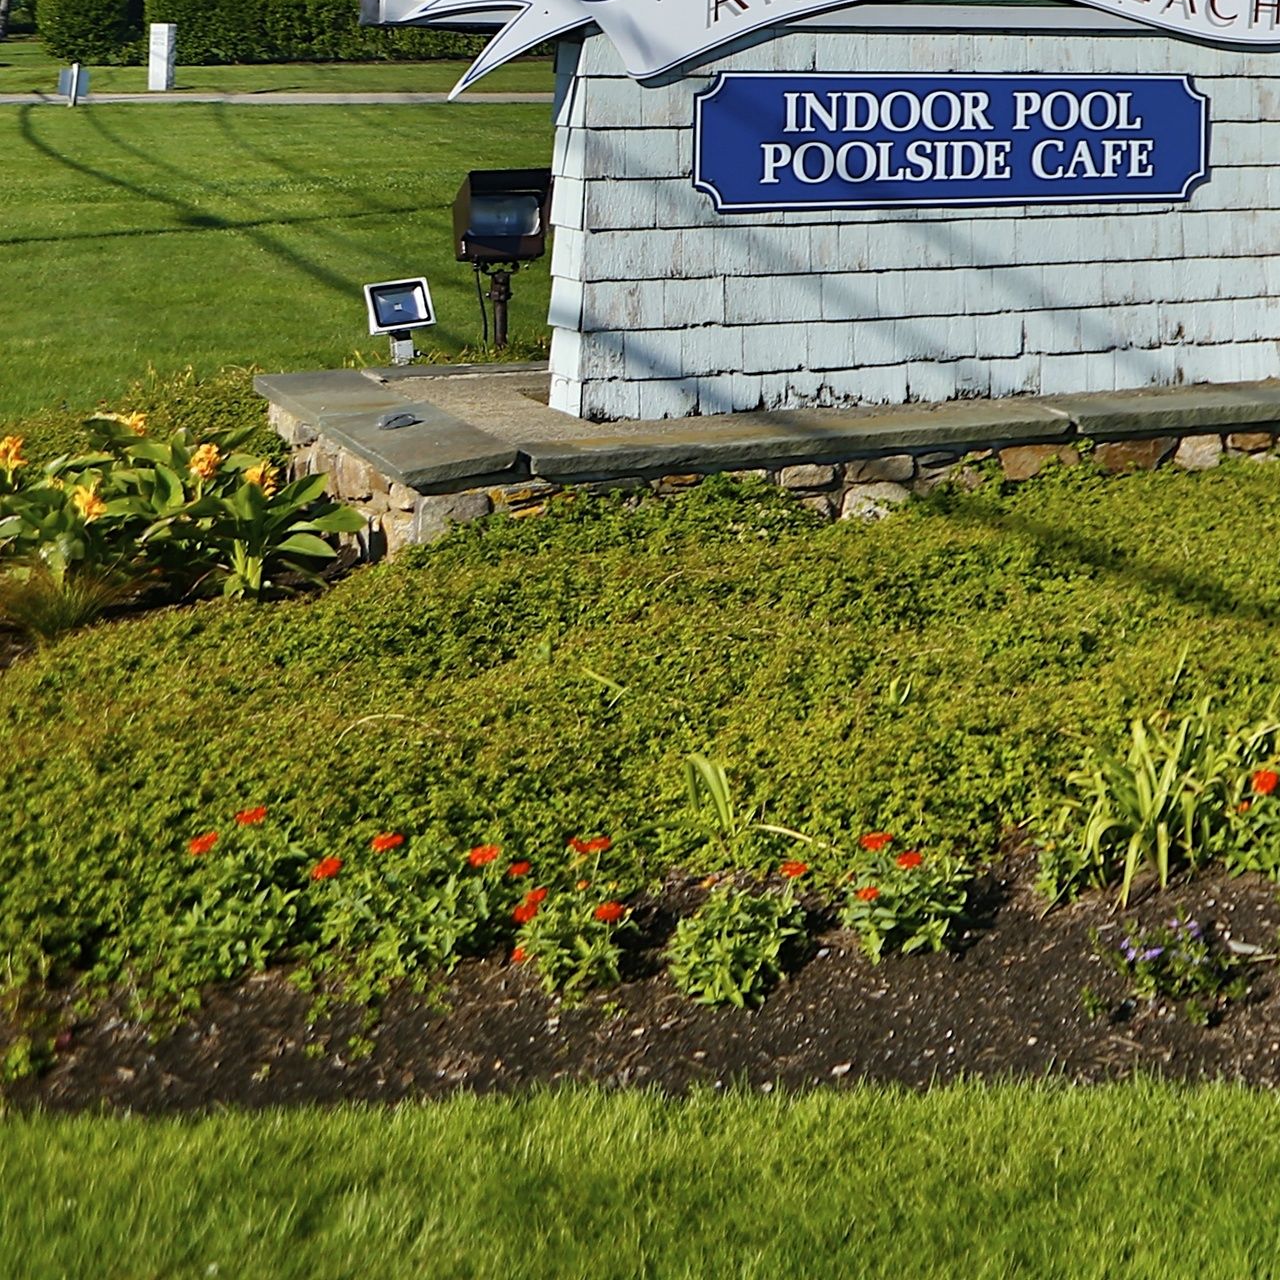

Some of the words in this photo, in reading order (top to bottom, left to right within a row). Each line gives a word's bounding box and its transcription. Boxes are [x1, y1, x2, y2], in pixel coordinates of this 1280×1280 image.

[783, 91, 994, 133] INDOOR
[1012, 91, 1142, 131] POOL
[759, 140, 1011, 185] POOLSIDE
[1031, 139, 1154, 180] CAFE
